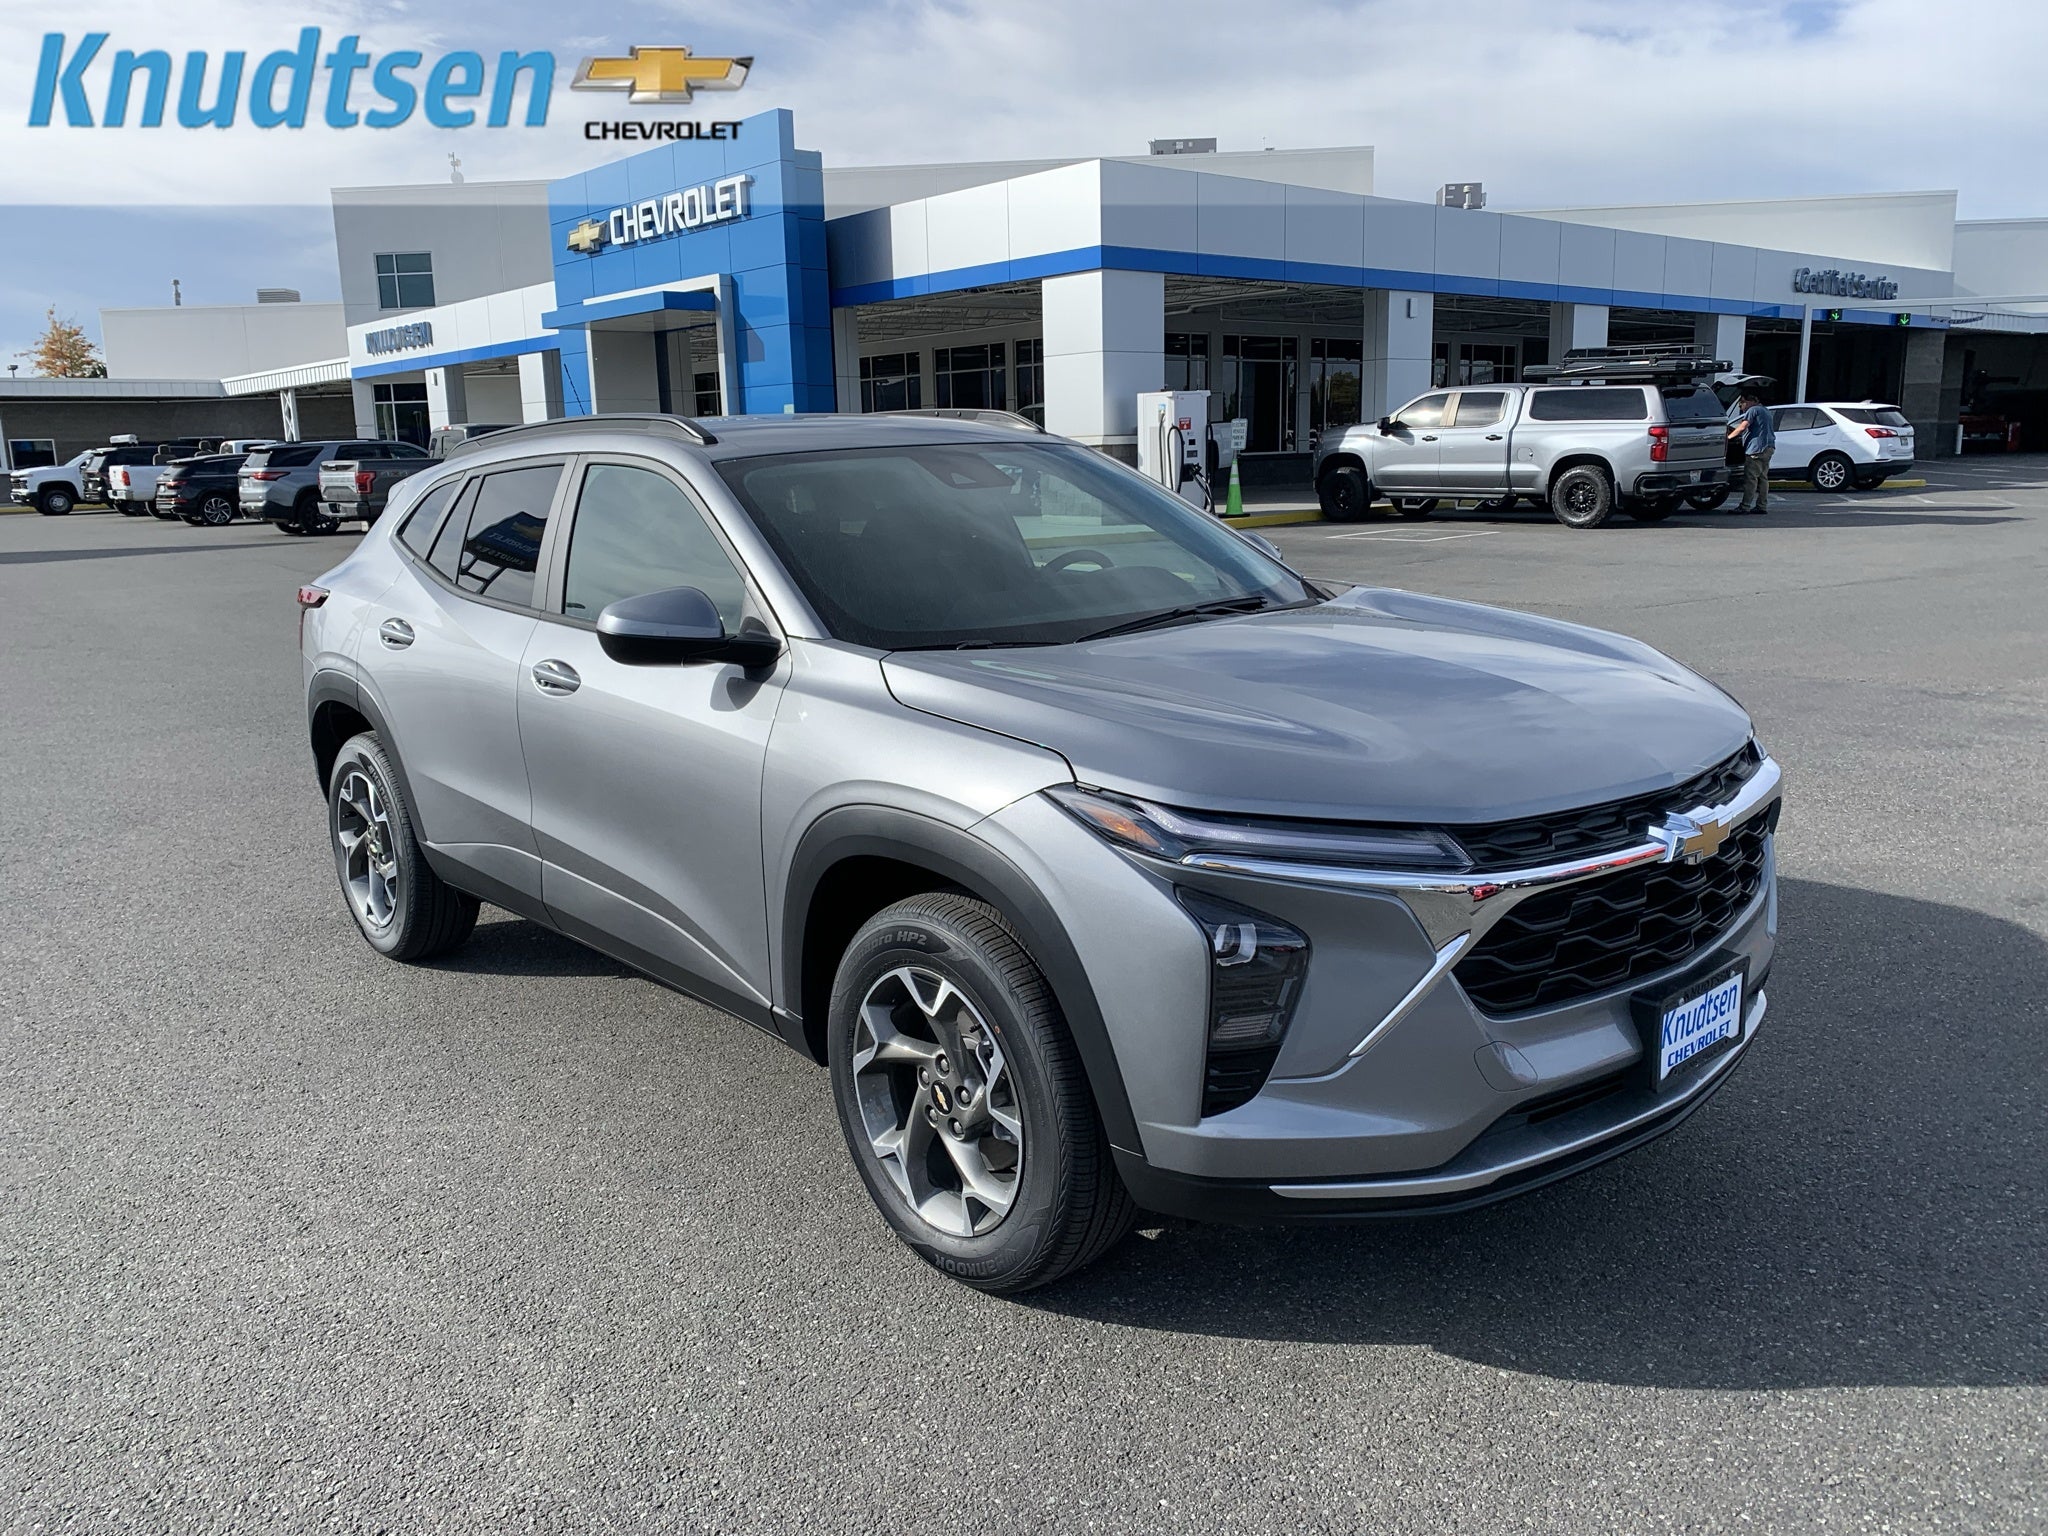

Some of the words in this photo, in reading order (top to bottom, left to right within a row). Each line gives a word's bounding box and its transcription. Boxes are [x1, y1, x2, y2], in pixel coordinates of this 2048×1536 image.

[609, 174, 752, 245] CHEVROLET
[896, 930, 928, 946] HP2
[1661, 984, 1738, 1050] Knudtsen
[1667, 1019, 1732, 1068] CHEVROLET
